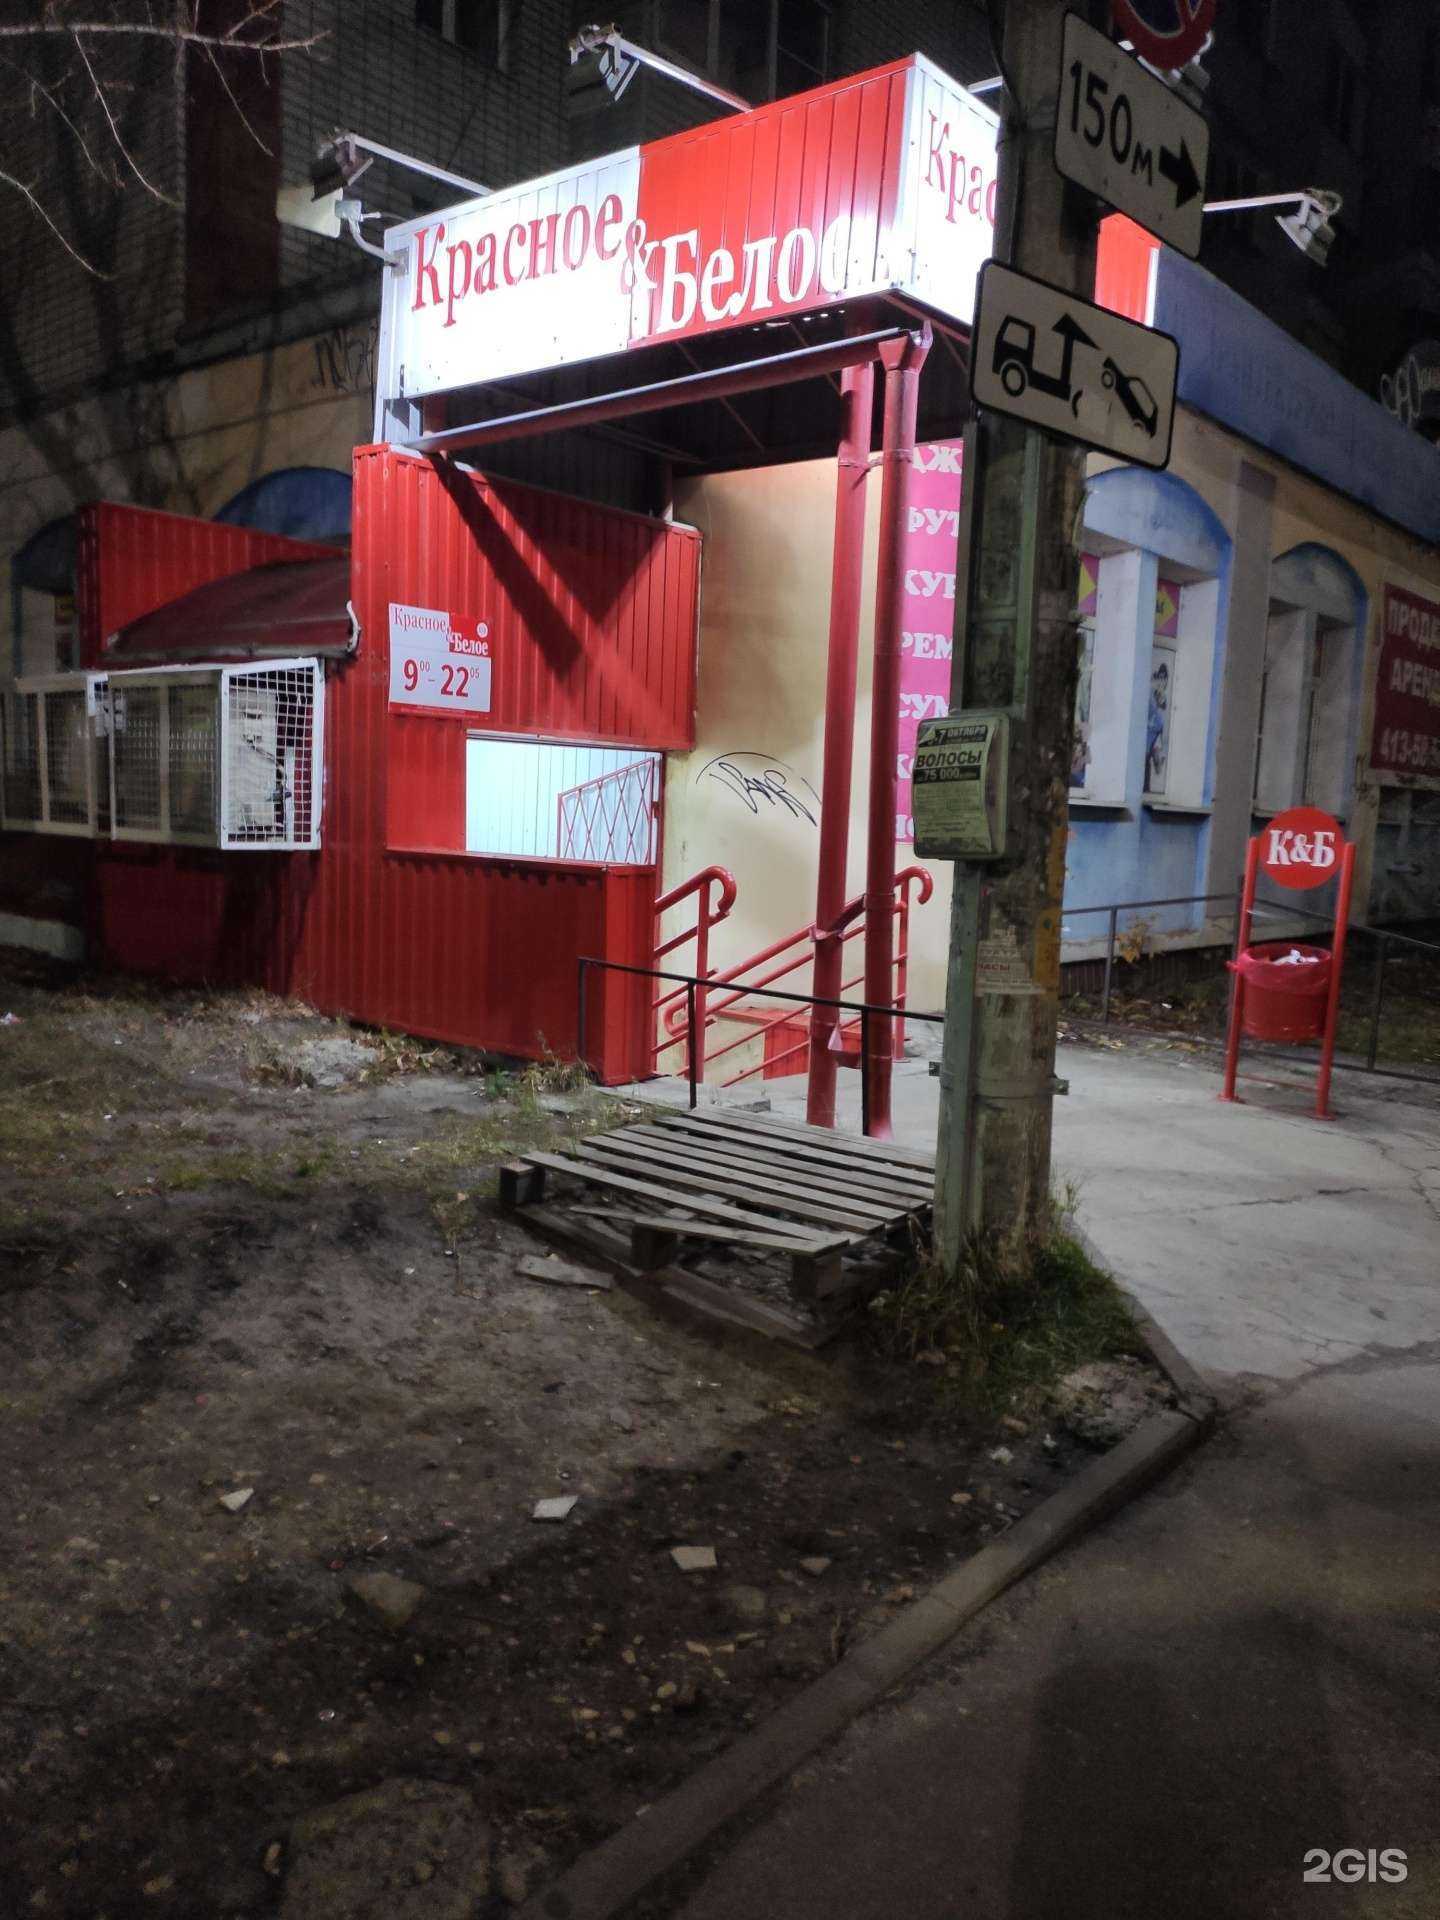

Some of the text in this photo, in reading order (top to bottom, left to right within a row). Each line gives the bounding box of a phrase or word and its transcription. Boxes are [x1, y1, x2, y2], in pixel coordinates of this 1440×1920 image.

[411, 194, 623, 328] Красное
[393, 607, 446, 632] Красное
[453, 632, 488, 655] Белое
[917, 750, 982, 768] ВОЛОСЫ
[1266, 829, 1335, 867] К&Б
